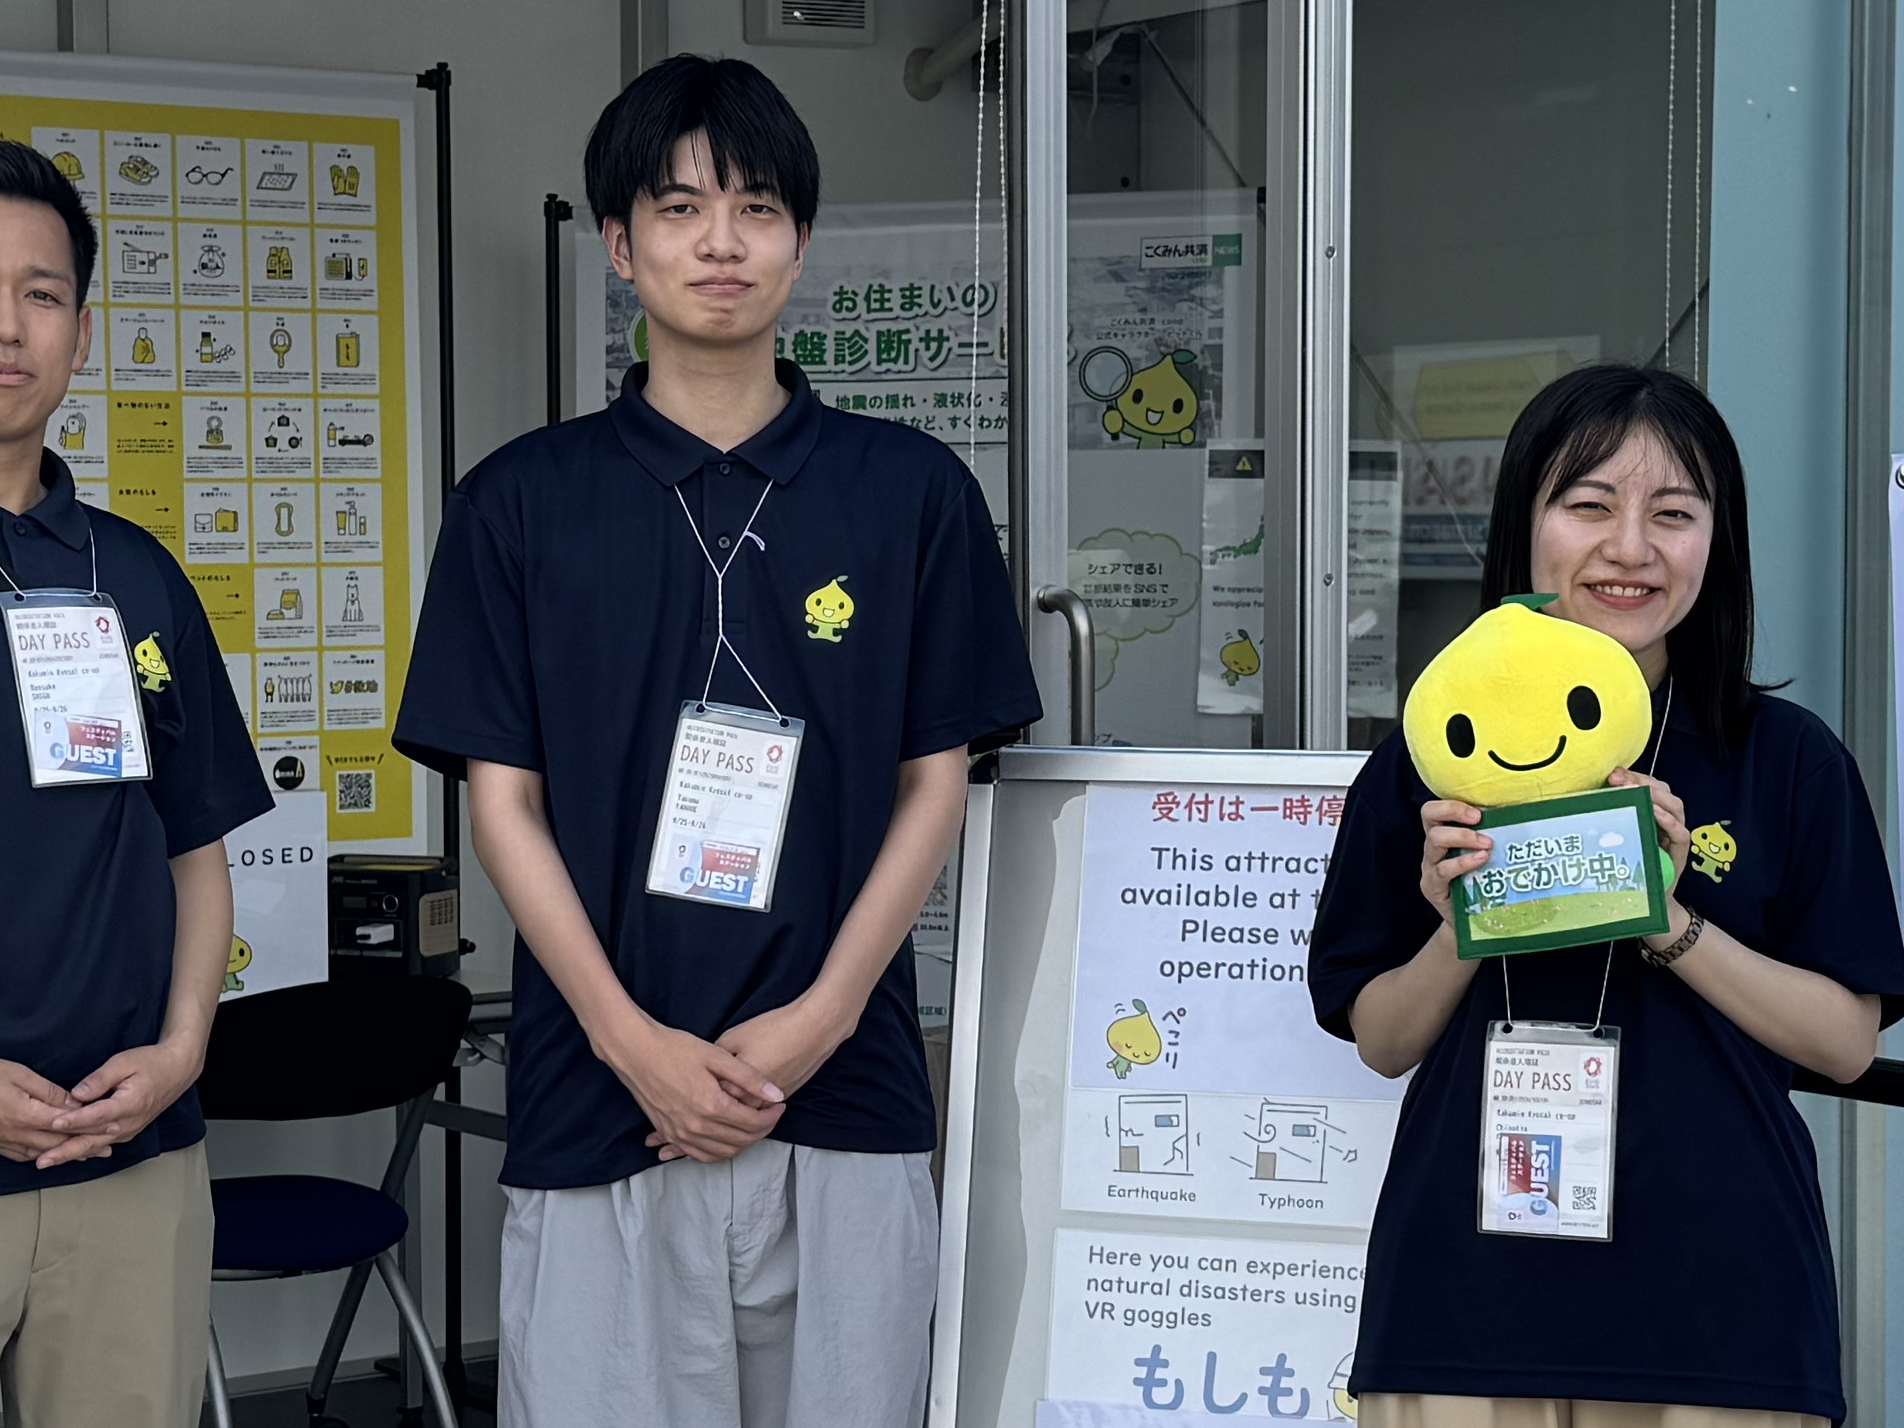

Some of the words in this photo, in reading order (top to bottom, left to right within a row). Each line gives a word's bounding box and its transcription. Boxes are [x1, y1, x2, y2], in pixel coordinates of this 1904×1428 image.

[1144, 243, 1209, 259] こくみん共済
[831, 282, 990, 315] お住まいの
[1227, 584, 1264, 595] apprecia
[18, 633, 47, 652] DAY
[53, 631, 91, 650] PASS
[49, 741, 117, 767] GUEST
[679, 744, 711, 766] DAY
[716, 751, 755, 775] PASS
[1151, 790, 1346, 827] 受付は一時停
[226, 846, 314, 868] OSED
[1150, 846, 1214, 872] This
[1224, 850, 1331, 875] attract
[1506, 834, 1583, 865] ただいま
[679, 866, 749, 894] GUEST
[1481, 853, 1631, 899] おでかけ中。
[1120, 882, 1258, 909] available
[1268, 887, 1302, 910] at
[1180, 918, 1280, 946] Please
[1158, 957, 1305, 985] operation
[1161, 1006, 1188, 1070] ぺこり
[1492, 1069, 1524, 1090] DAY
[1531, 1071, 1572, 1092] PASS
[1530, 1140, 1552, 1216] GUEST
[1107, 1184, 1197, 1205] Earthquake
[1258, 1193, 1324, 1212] Typhoon
[1088, 1245, 1142, 1268] Here
[1149, 1252, 1190, 1277] you
[1197, 1255, 1238, 1274] can
[1086, 1274, 1171, 1297] natural
[1179, 1280, 1286, 1306] disasters
[1294, 1287, 1357, 1313] using
[1084, 1301, 1116, 1322] VR
[1123, 1305, 1212, 1330] goggles
[1132, 1343, 1311, 1420] もしも
